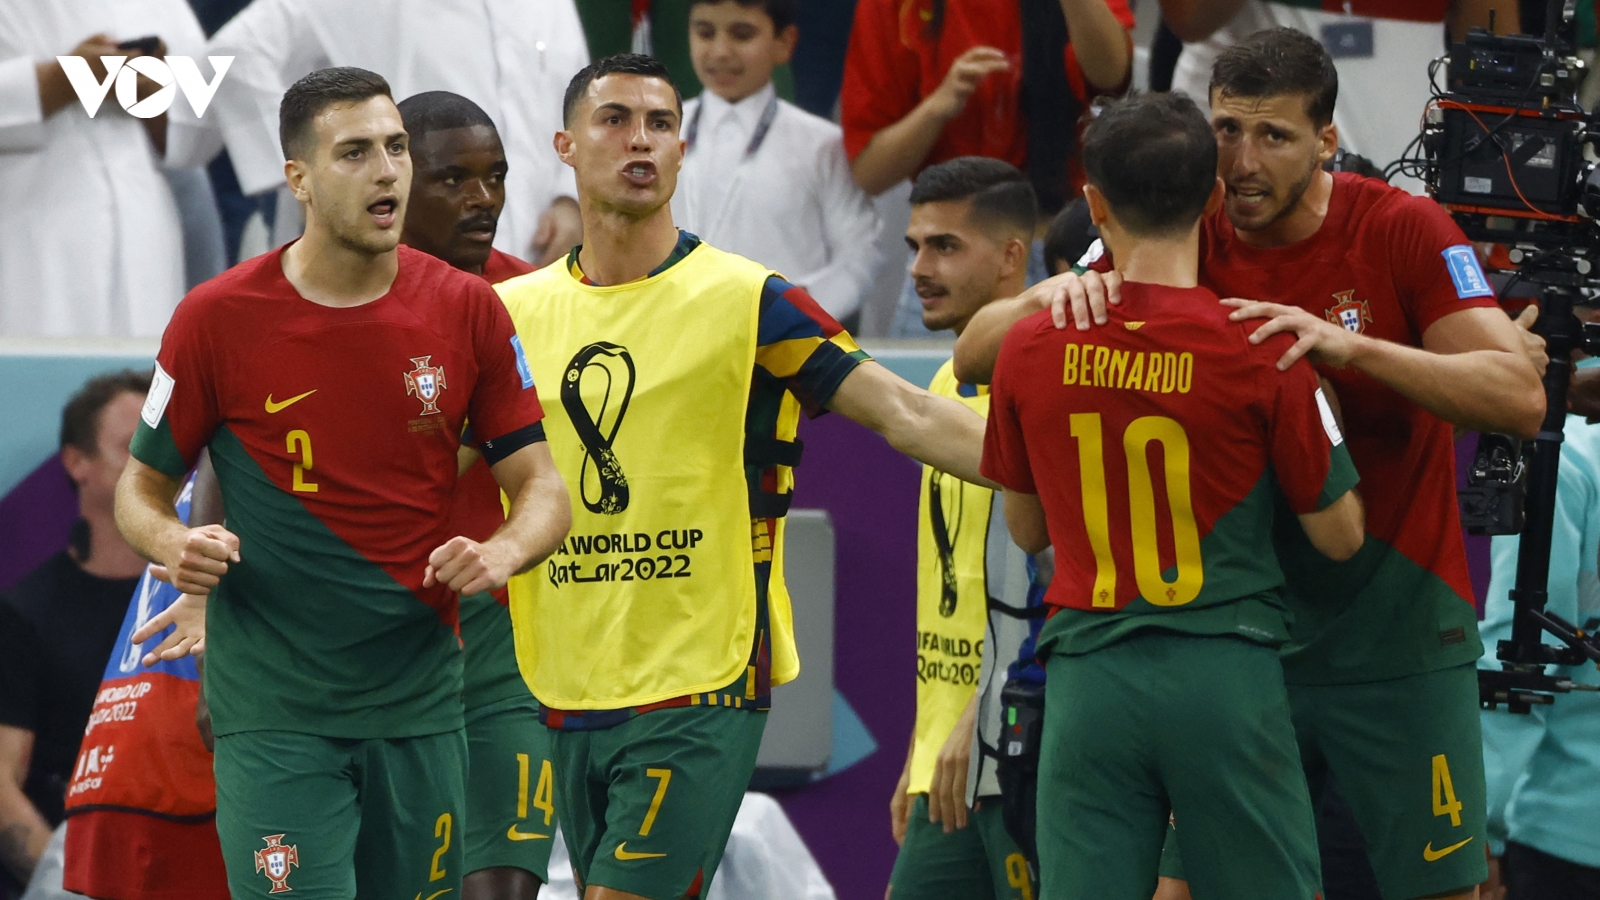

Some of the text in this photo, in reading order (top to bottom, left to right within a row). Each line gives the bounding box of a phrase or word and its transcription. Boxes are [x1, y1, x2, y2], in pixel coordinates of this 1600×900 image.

[1063, 343, 1194, 394] BERNARDO
[286, 429, 318, 493] 2
[570, 533, 652, 556] WORLD
[656, 528, 704, 550] CUP
[1069, 412, 1204, 608] 10
[516, 753, 554, 826] 14
[638, 768, 672, 836] 7
[1432, 753, 1463, 827] 4
[429, 812, 452, 882] 2
[1004, 853, 1034, 900] 9
